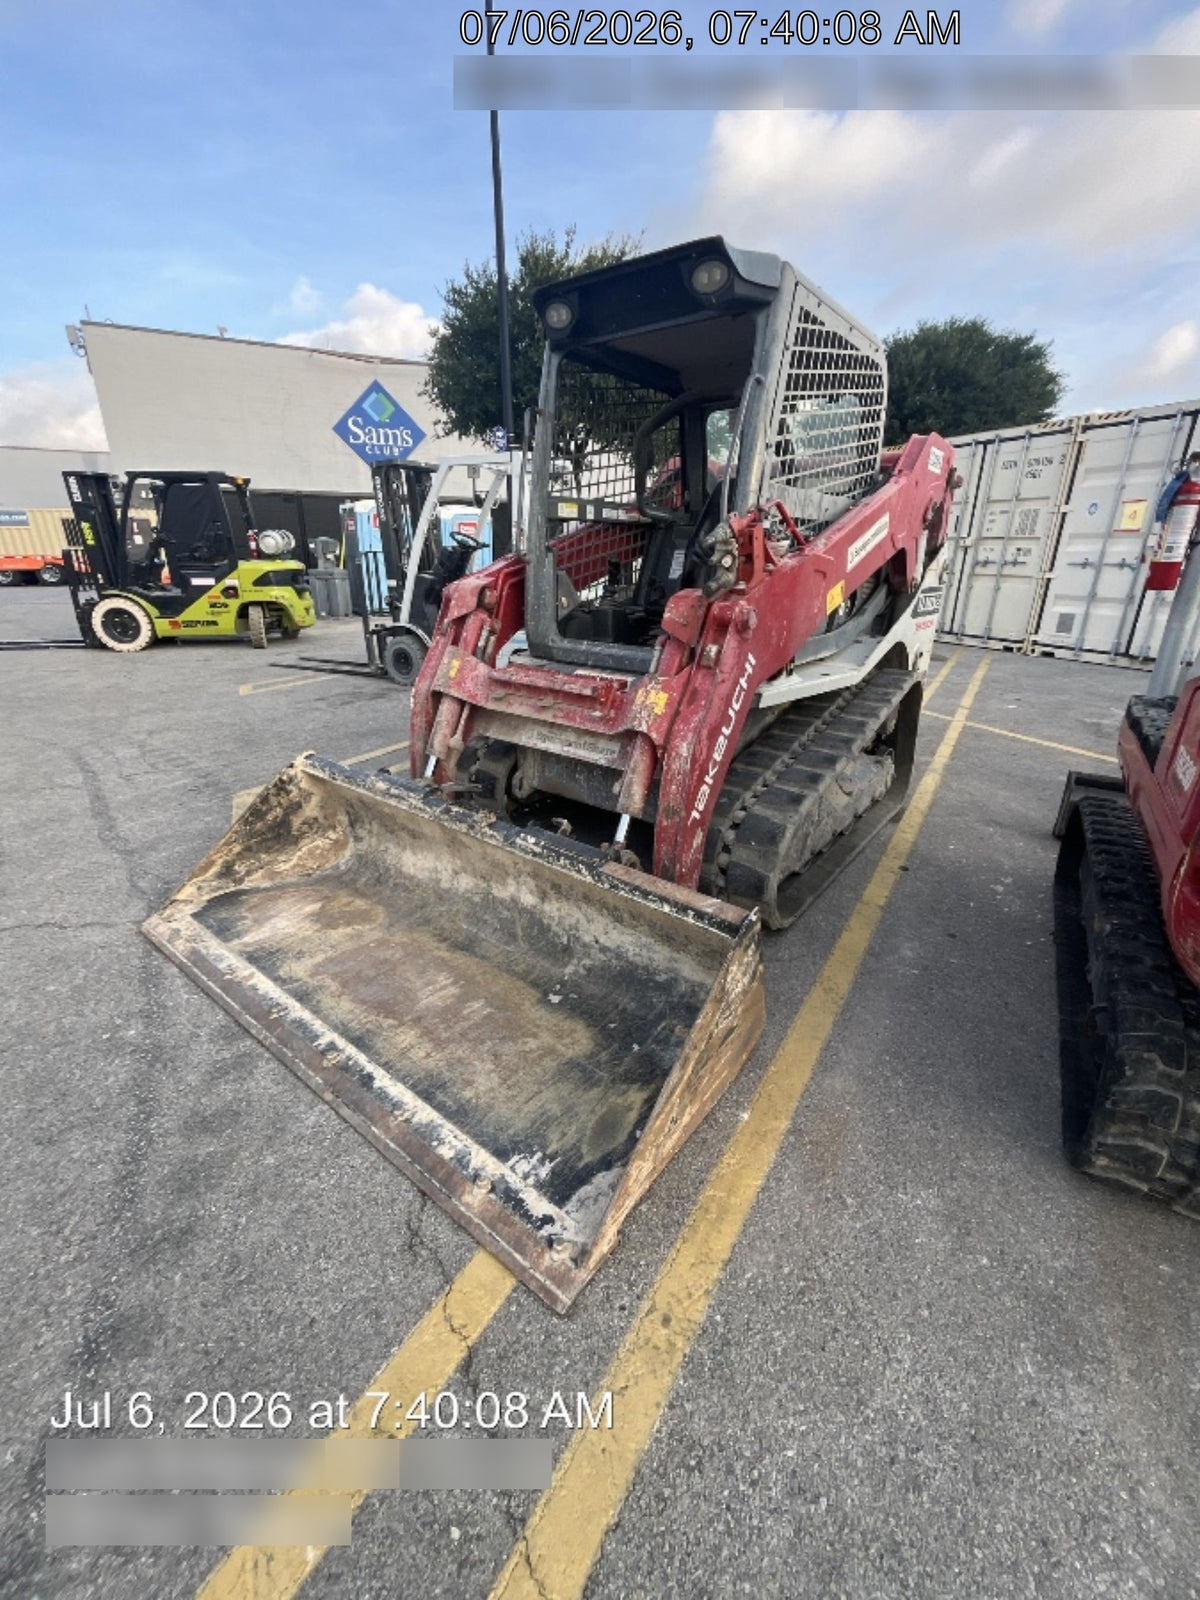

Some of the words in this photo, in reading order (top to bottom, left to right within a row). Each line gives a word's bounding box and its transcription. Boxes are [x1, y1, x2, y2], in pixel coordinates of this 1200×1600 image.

[347, 415, 413, 447] Sam's
[365, 445, 400, 456] CLUB
[1128, 509, 1138, 521] 4
[687, 652, 757, 827] TAKEUCHI
